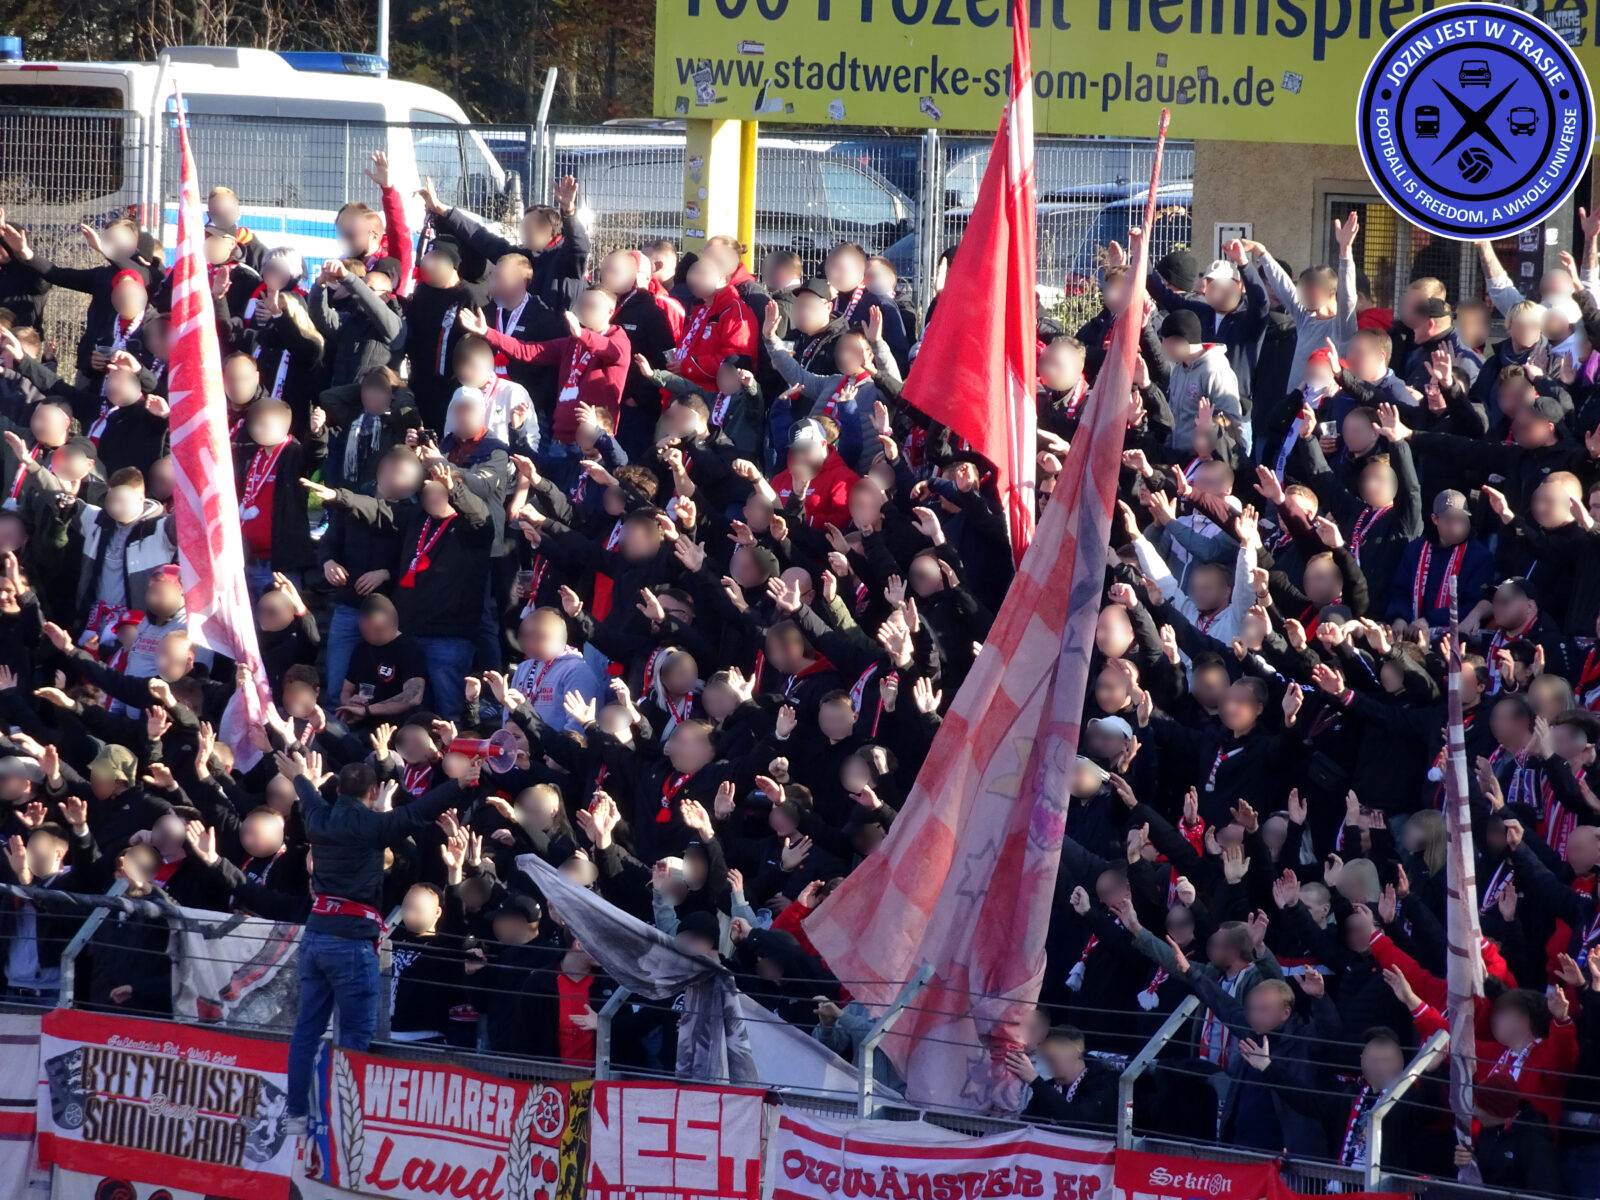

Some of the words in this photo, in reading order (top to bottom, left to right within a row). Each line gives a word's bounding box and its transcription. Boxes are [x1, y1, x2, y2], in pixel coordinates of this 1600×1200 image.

[675, 51, 1275, 112] www.stadtwerke-stom-plauen.de
[82, 1046, 260, 1119] KYFFHÄUSER
[364, 1064, 516, 1138] WEIMARER
[365, 1136, 506, 1200] Land
[1149, 1167, 1232, 1196] Sektion
